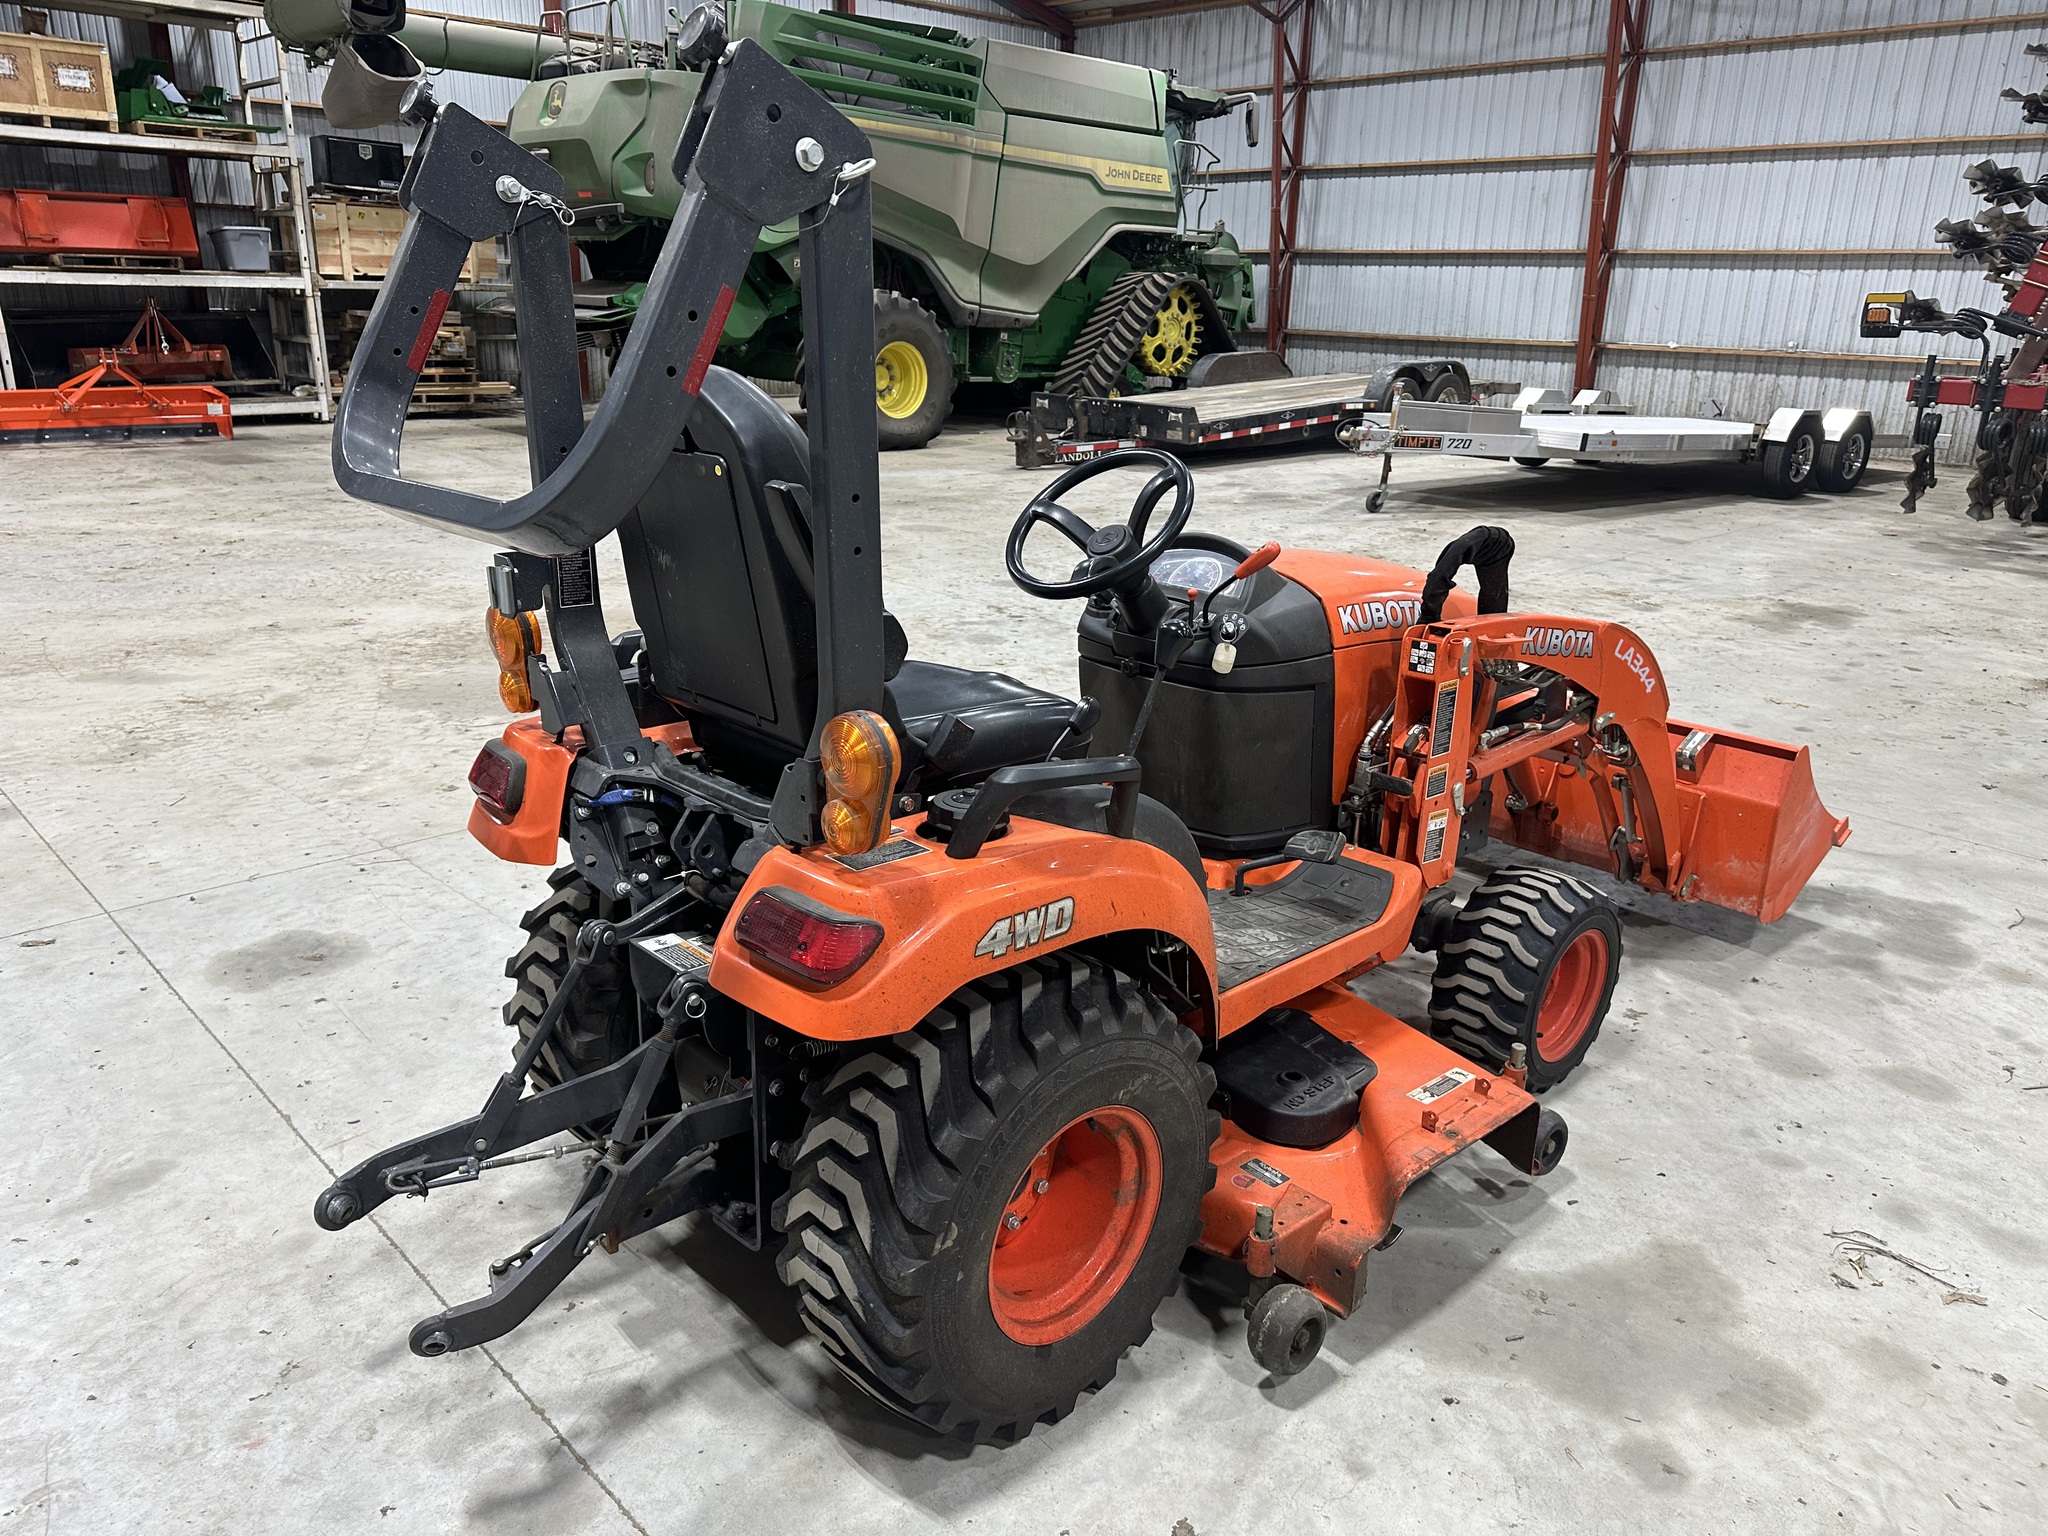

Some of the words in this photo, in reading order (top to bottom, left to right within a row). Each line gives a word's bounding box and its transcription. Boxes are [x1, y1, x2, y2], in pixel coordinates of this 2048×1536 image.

[1105, 166, 1131, 180] JOHN
[1132, 169, 1163, 184] DEERE
[1397, 436, 1441, 449] TIMPTE
[1447, 438, 1473, 449] 720
[1521, 626, 1595, 658] KUBOTA
[1614, 638, 1656, 693] LA344
[974, 895, 1076, 960] 4WD
[1283, 1095, 1306, 1111] NO
[1303, 1075, 1335, 1098] STEP
